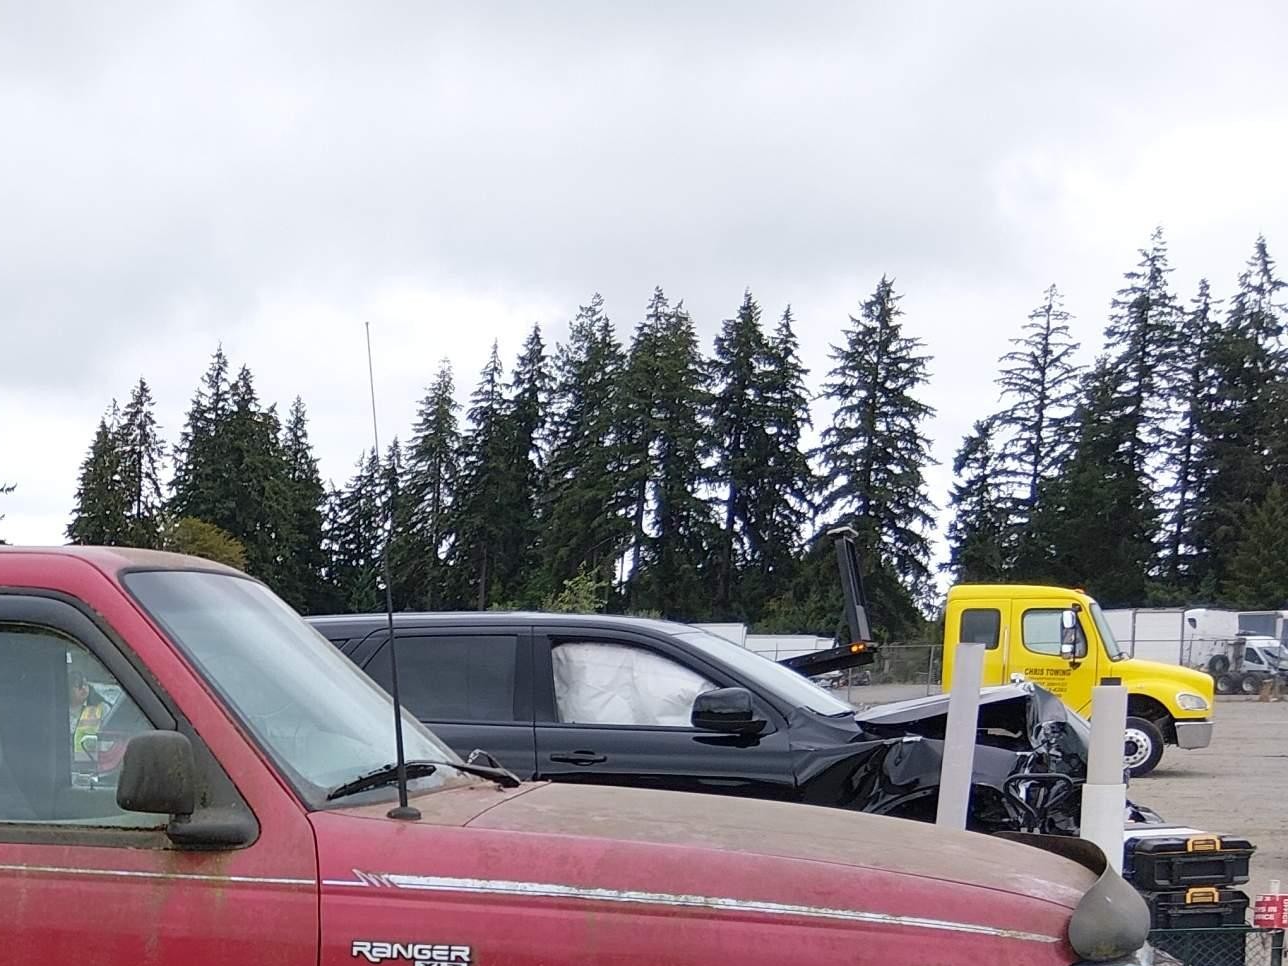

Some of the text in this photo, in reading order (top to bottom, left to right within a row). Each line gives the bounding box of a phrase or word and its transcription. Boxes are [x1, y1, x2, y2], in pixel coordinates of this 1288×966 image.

[1024, 667, 1072, 676] CHRIS TOWING
[352, 941, 470, 962] RANGER
